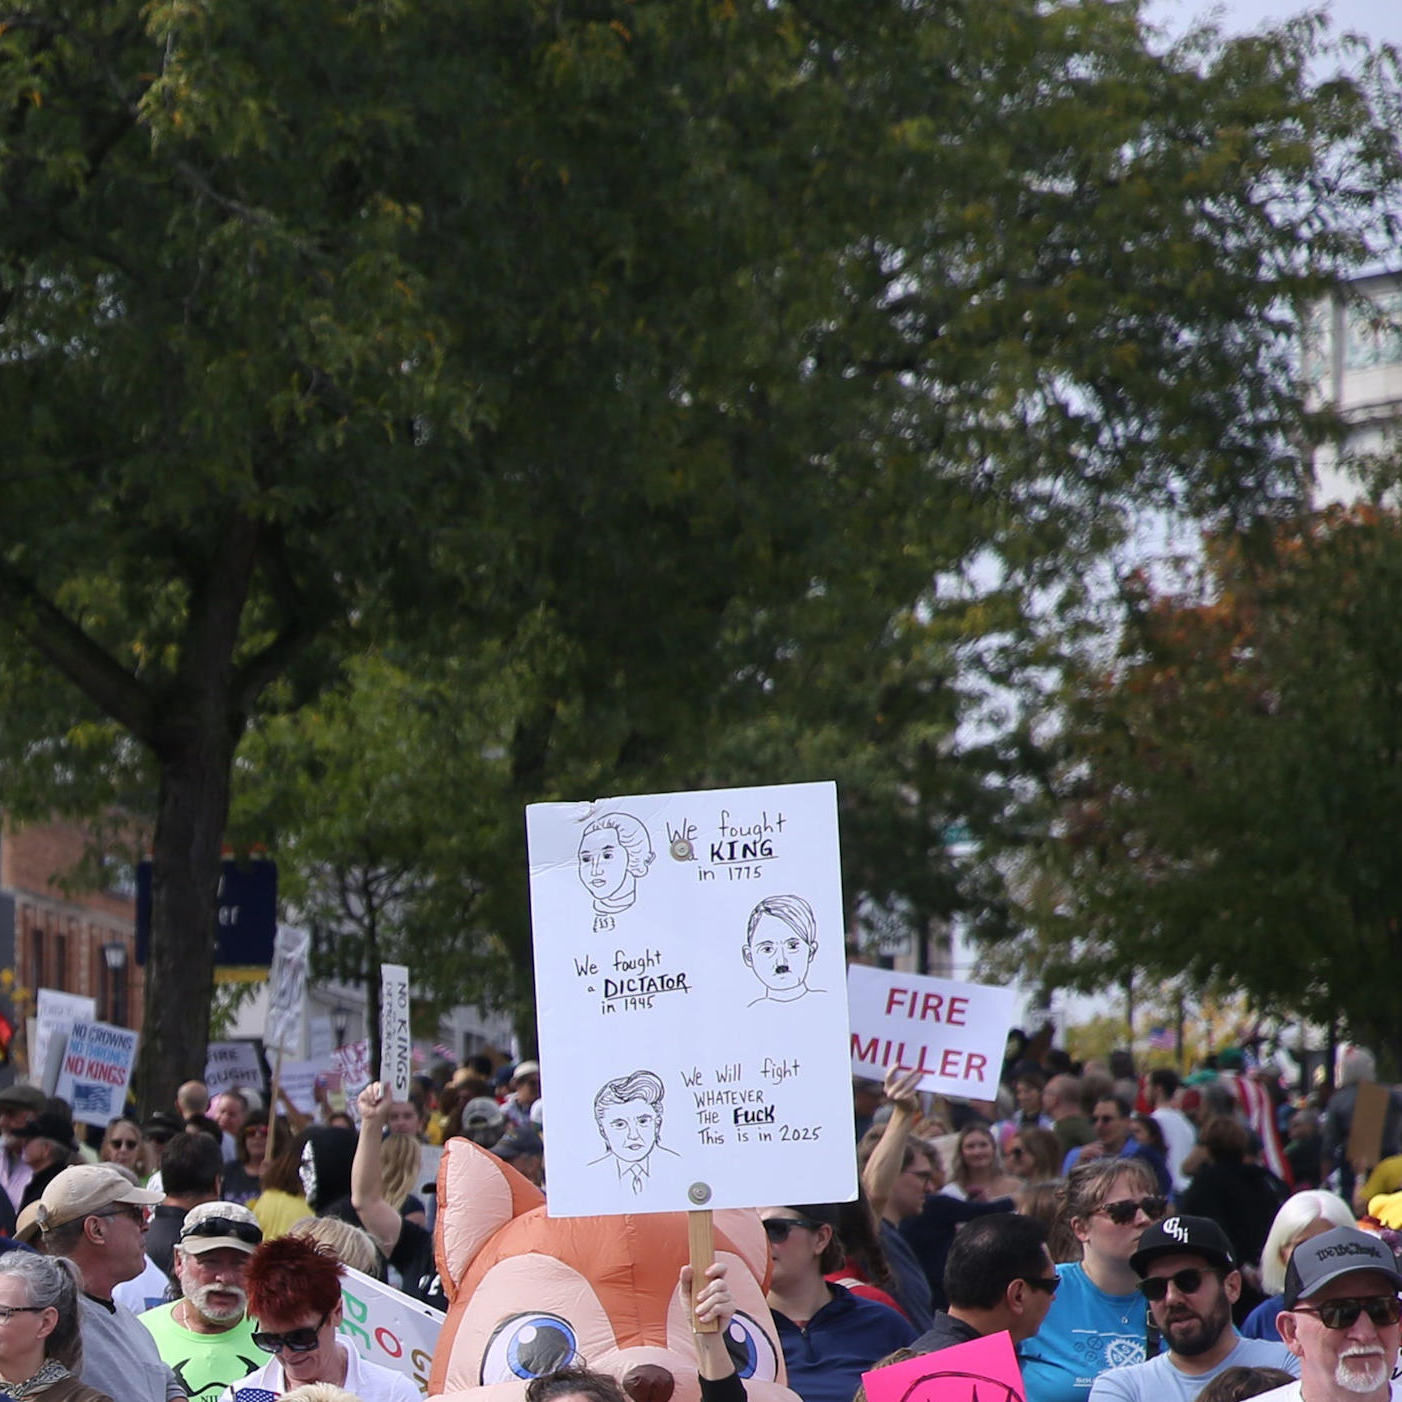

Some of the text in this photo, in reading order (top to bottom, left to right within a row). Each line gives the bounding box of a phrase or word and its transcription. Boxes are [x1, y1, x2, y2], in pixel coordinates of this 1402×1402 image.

[667, 810, 786, 845] We fought
[711, 839, 773, 861] KING
[698, 866, 762, 881] in 1775
[574, 949, 662, 978] We fought
[398, 982, 407, 1008] NO
[587, 973, 689, 998] a DICTATOR
[601, 997, 655, 1014] in 1945
[885, 986, 970, 1027] FIRE
[72, 1023, 133, 1050] NO CROWNS
[396, 1020, 408, 1090] KINGS
[849, 1032, 988, 1083] MILLER
[65, 1056, 126, 1087] NO KINGS
[680, 1069, 703, 1088] We
[760, 1057, 800, 1087] fight
[694, 1089, 764, 1107] WHATEVER
[698, 1126, 823, 1145] This is in 2025
